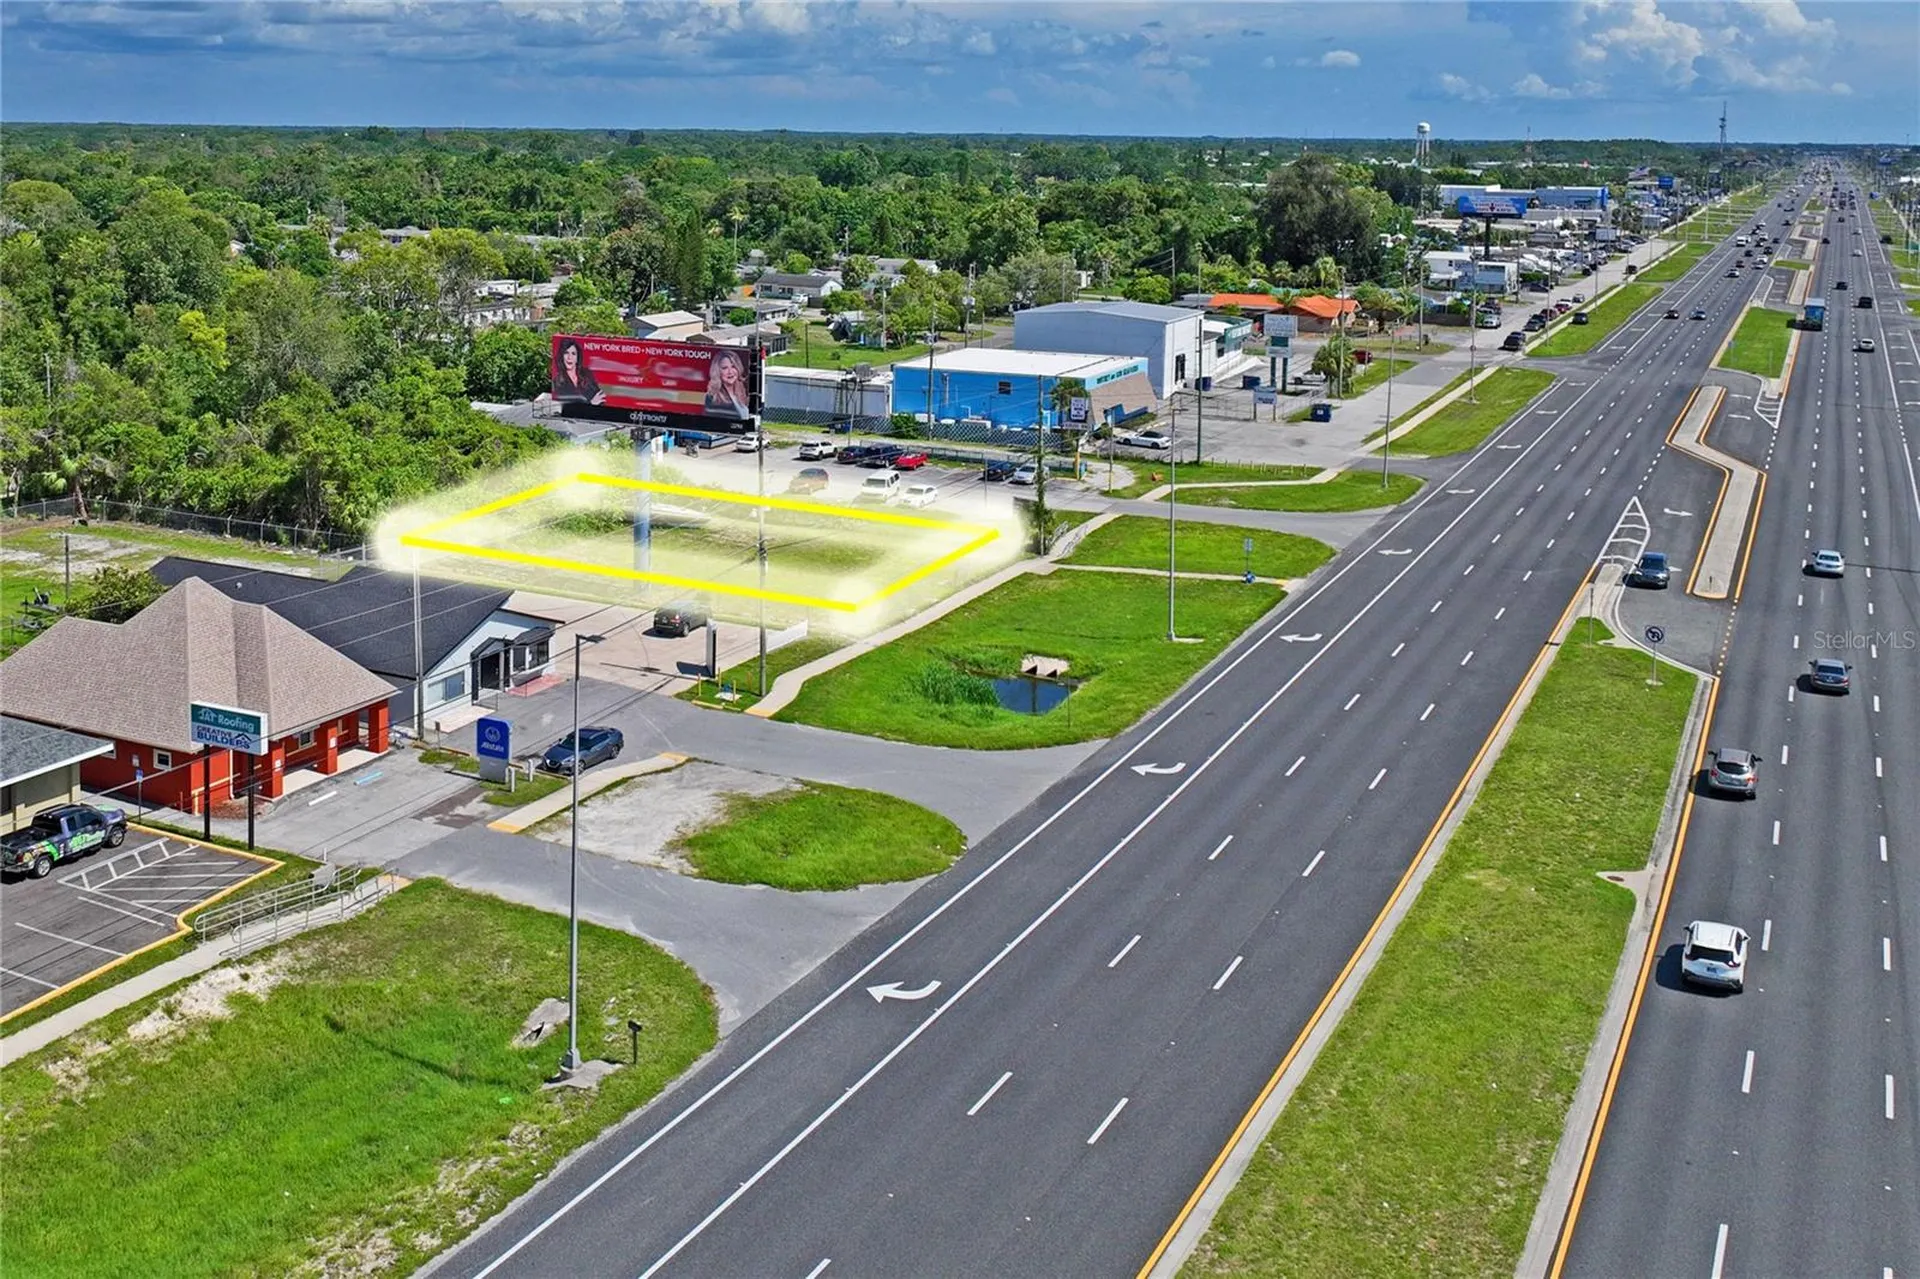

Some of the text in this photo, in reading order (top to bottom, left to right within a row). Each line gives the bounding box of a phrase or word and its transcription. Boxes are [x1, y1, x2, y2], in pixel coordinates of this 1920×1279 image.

[583, 342, 712, 359] NEW YORK BRED NEW YORK TOUGH
[196, 725, 232, 737] CREATIVE
[217, 714, 255, 733] Roofing
[196, 731, 250, 750] BUILDERS
